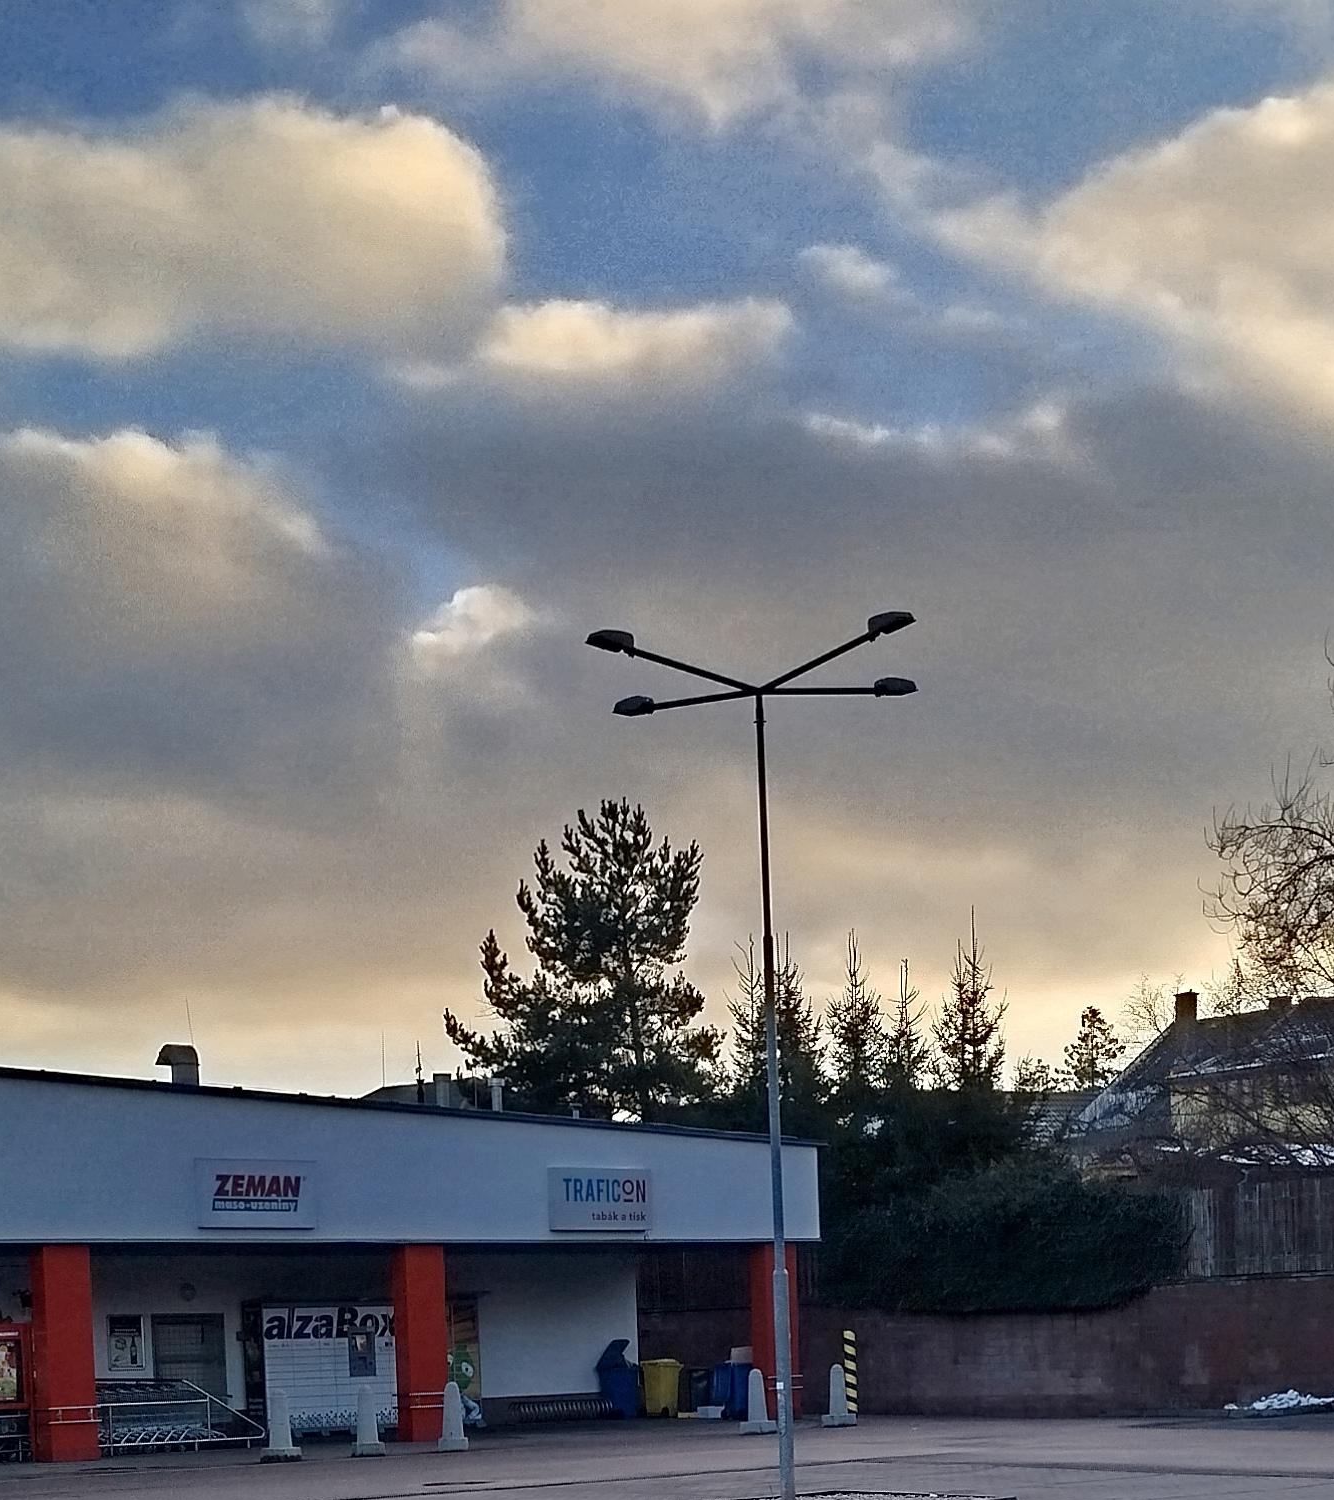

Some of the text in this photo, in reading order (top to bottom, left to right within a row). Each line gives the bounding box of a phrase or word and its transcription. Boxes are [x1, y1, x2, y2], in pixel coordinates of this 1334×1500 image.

[213, 1174, 301, 1198] ZEMAN
[562, 1178, 646, 1203] TRAFICON
[592, 1211, 647, 1221] tabák a tisk
[264, 1307, 395, 1340] alzaBox
